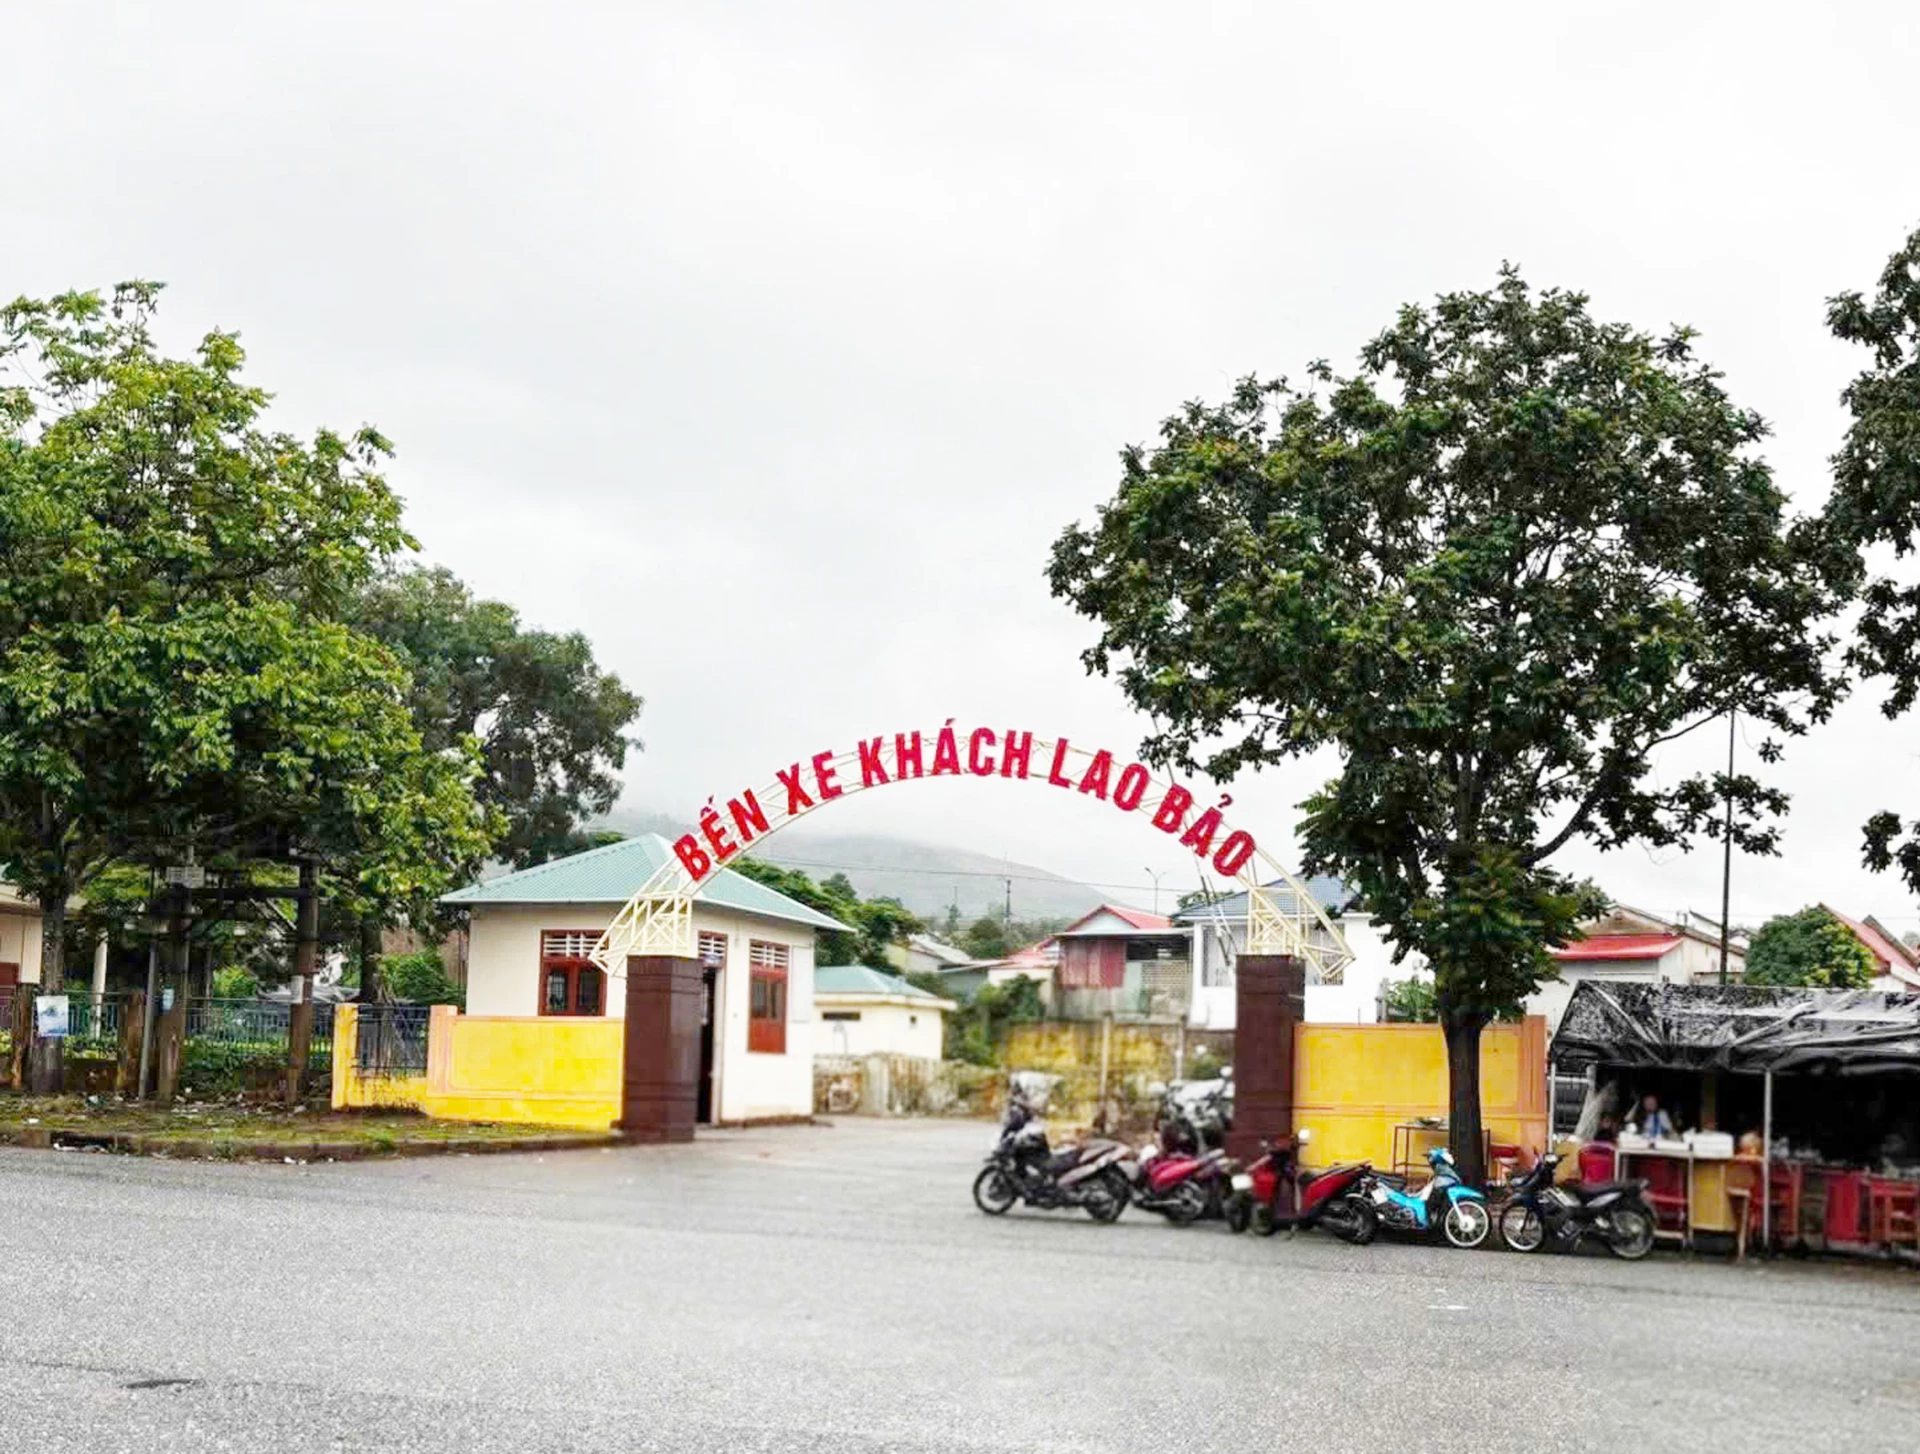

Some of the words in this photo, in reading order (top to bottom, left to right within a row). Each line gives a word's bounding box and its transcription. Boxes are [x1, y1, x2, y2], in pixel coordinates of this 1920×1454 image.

[673, 788, 770, 882] BẾN
[776, 750, 843, 815] XE
[858, 718, 1033, 788] KHÁCH
[1048, 737, 1151, 812] LAO
[1151, 782, 1256, 877] BẢO
